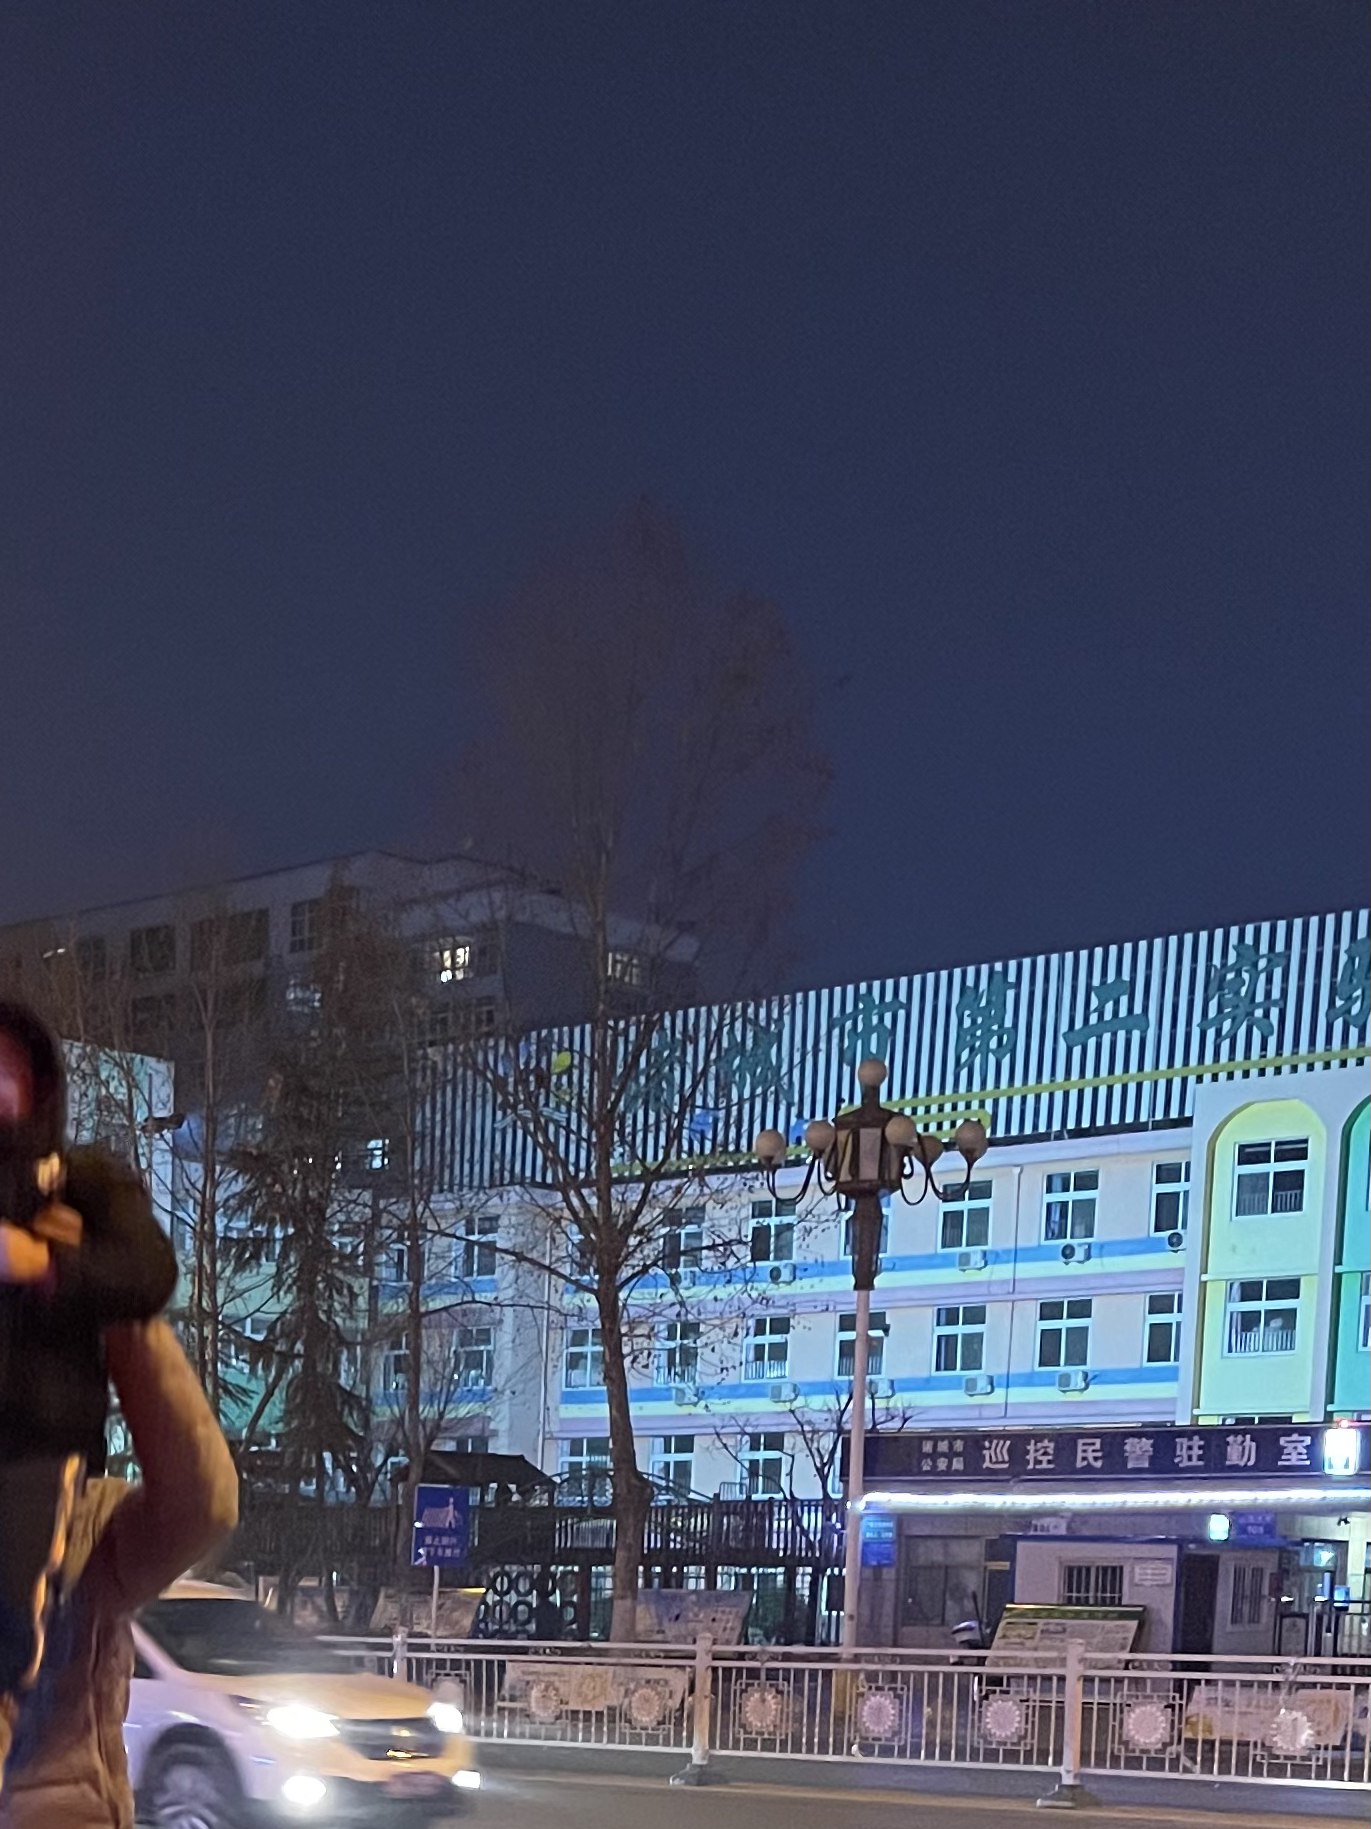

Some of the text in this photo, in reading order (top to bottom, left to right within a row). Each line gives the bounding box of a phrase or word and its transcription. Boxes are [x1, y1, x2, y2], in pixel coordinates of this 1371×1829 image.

[982, 1433, 1311, 1470] 巡控民警驻勤室
